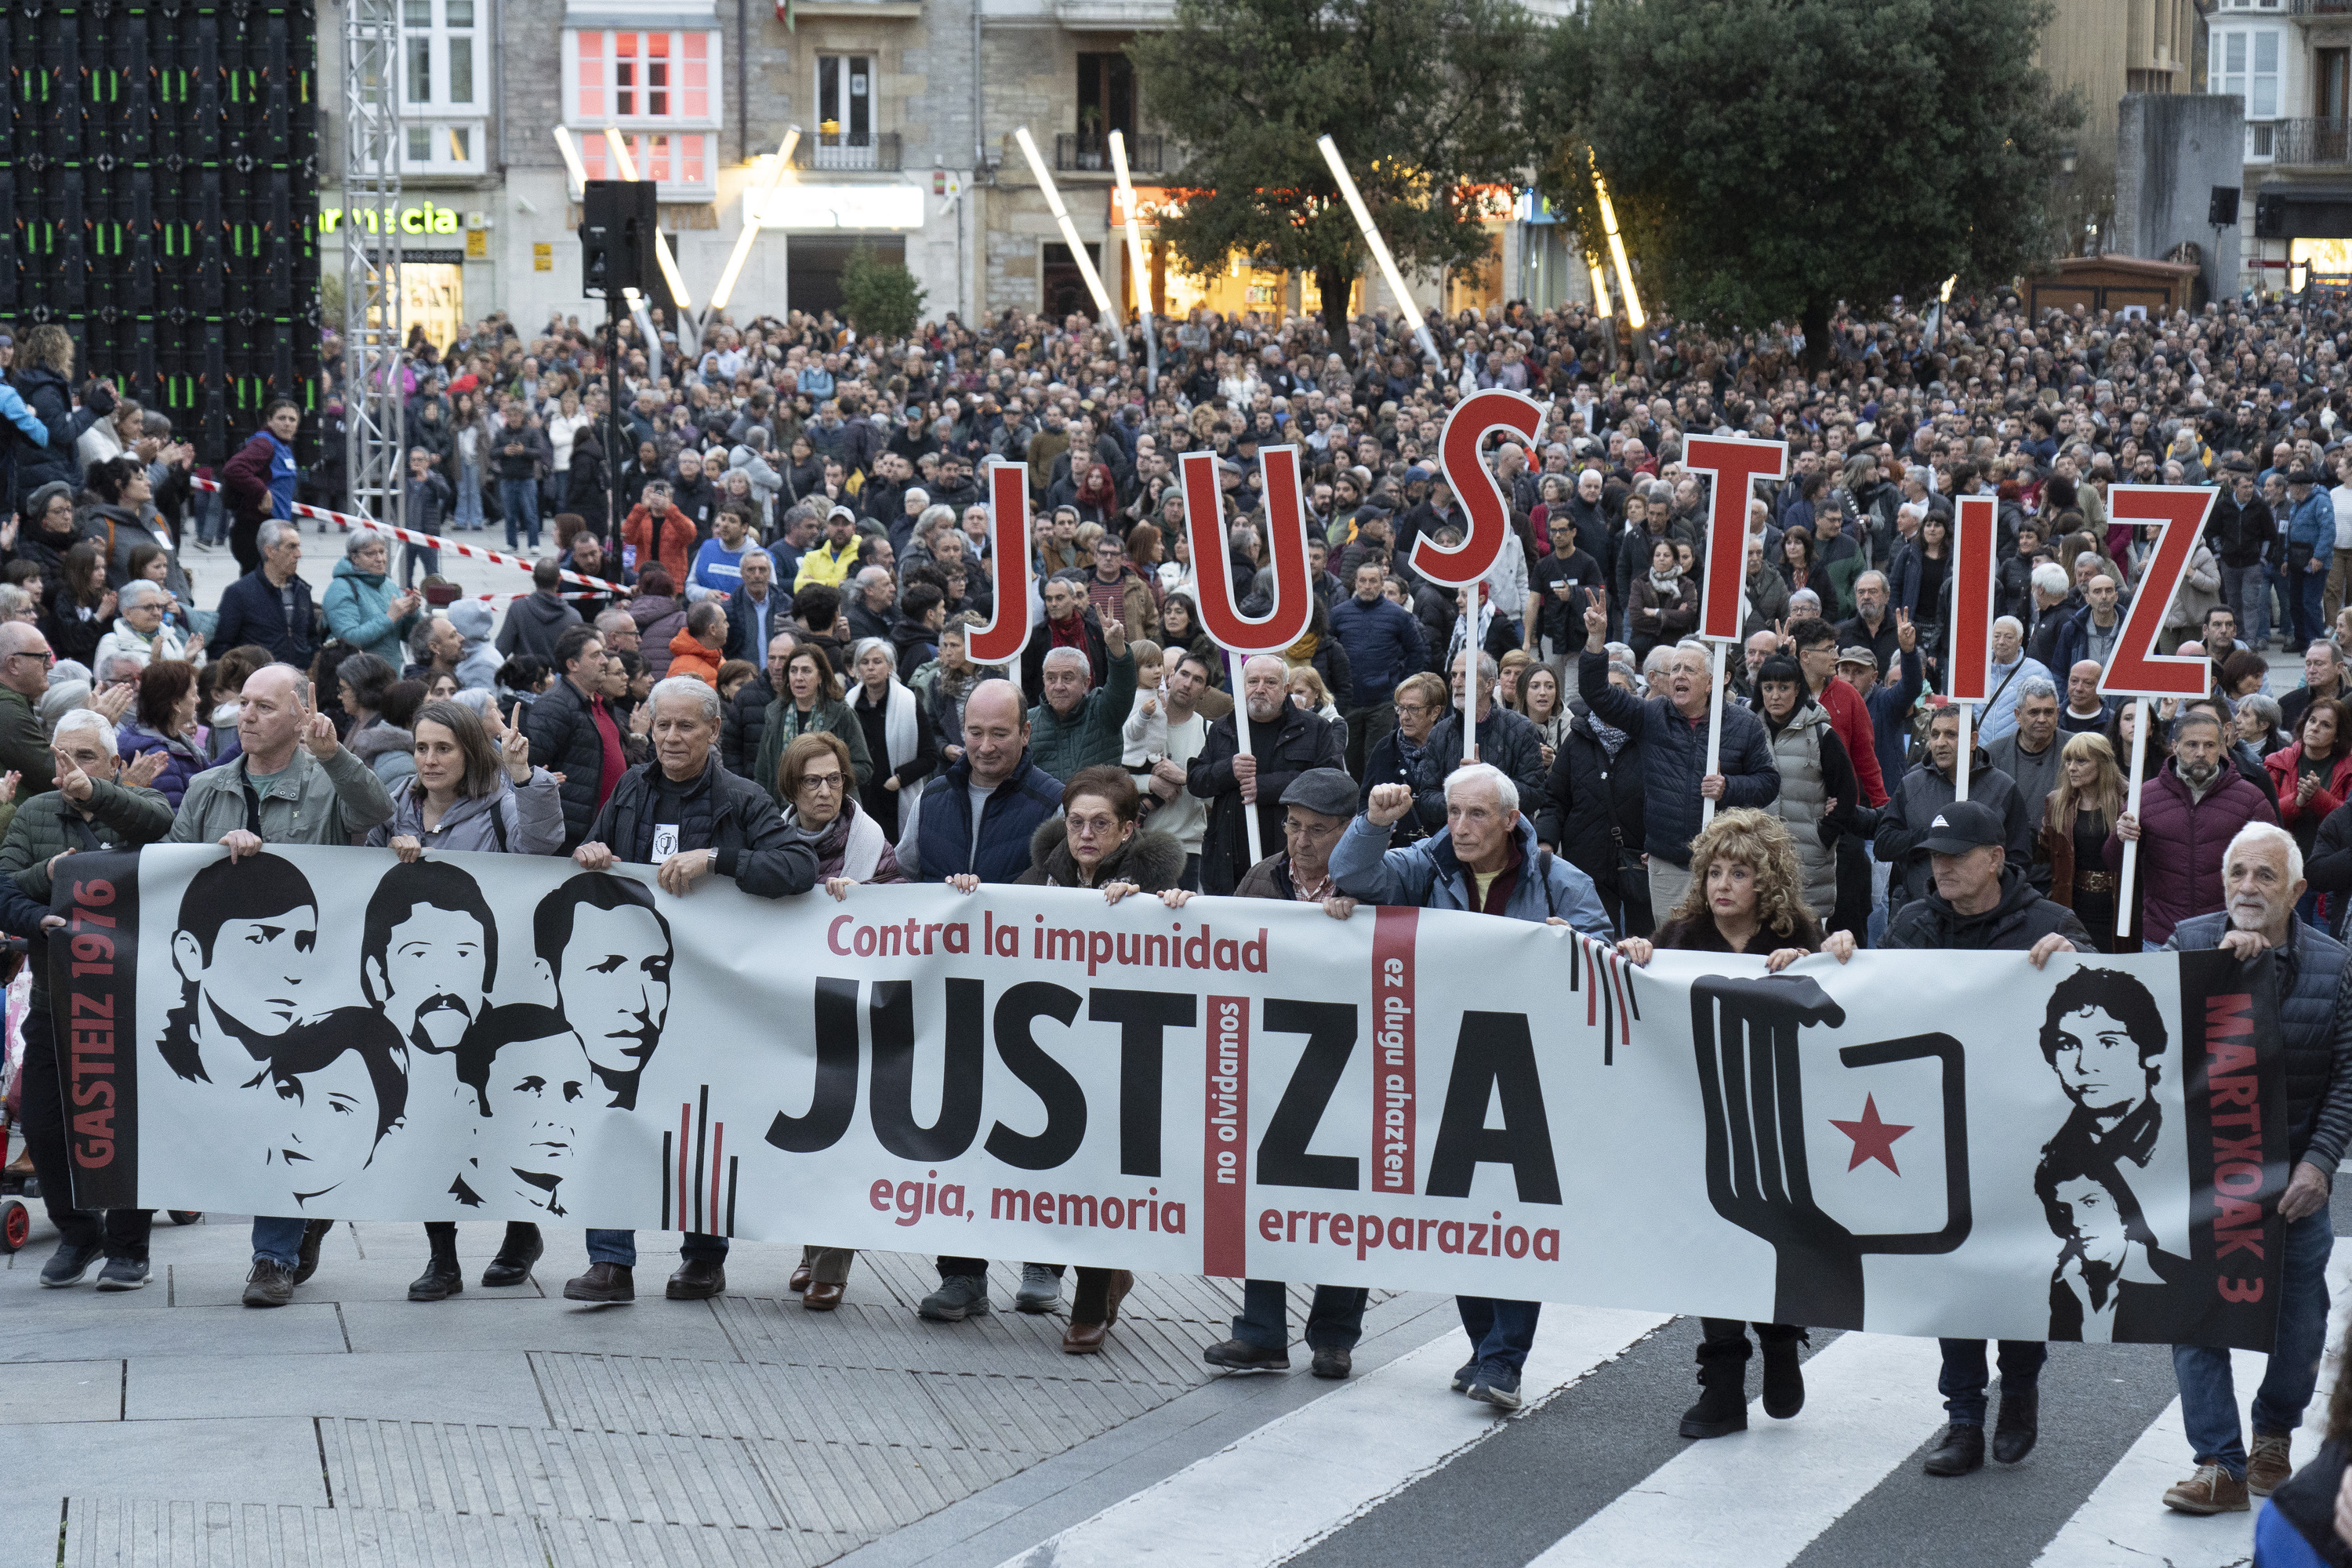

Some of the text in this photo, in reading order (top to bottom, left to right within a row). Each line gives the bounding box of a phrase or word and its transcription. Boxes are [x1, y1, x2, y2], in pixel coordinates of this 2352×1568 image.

[967, 465, 1029, 662] J
[1181, 448, 1309, 651] U
[1412, 392, 1544, 584] S
[1684, 437, 1784, 640] T
[1951, 498, 1995, 701] I
[2105, 488, 2214, 696] Z
[71, 878, 116, 1169] GASTEIZ 1976
[827, 910, 1268, 976] Contra la impunidad
[1210, 1002, 1240, 1185] no olvidamos
[1377, 958, 1411, 1188] ez dugu ahazten
[2205, 993, 2265, 1304] MARTXOAK 3
[869, 1170, 1186, 1234] egia, memoria
[1259, 1210, 1560, 1261] erreparazioa
